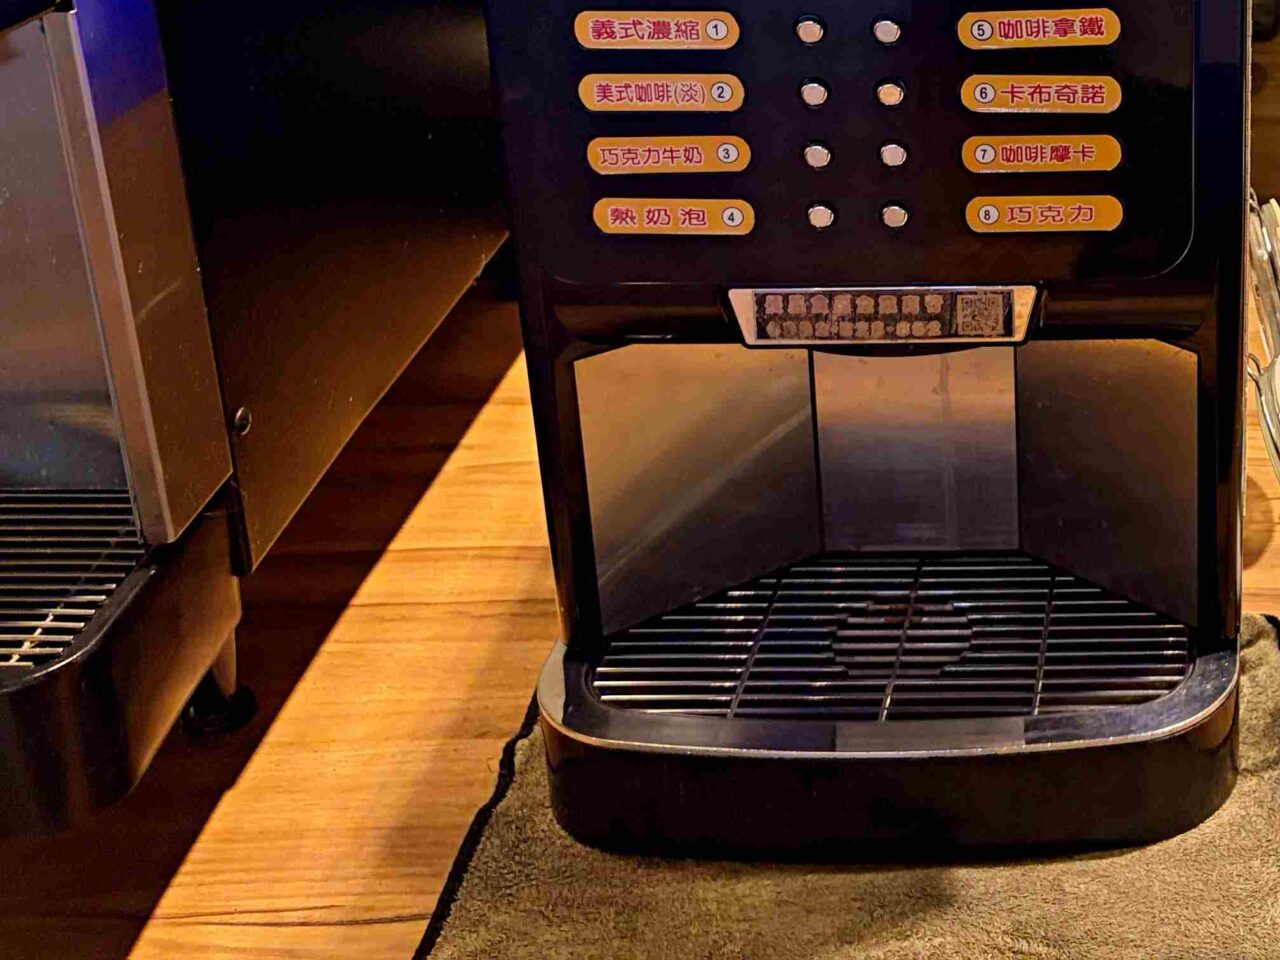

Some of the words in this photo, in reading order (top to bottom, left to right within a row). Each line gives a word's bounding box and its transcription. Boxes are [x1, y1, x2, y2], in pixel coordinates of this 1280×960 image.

[590, 19, 700, 41] 義式濃縮
[998, 15, 1105, 40] 咖啡拿鐵
[595, 82, 706, 105] 美式咖啡(淡)
[1000, 83, 1106, 105] 卡布奇諾
[599, 145, 703, 166] 巧克力牛奶
[1001, 143, 1096, 163] 咖啡摩卡
[609, 206, 708, 227] 熱奶泡
[1006, 204, 1095, 224] 巧克力
